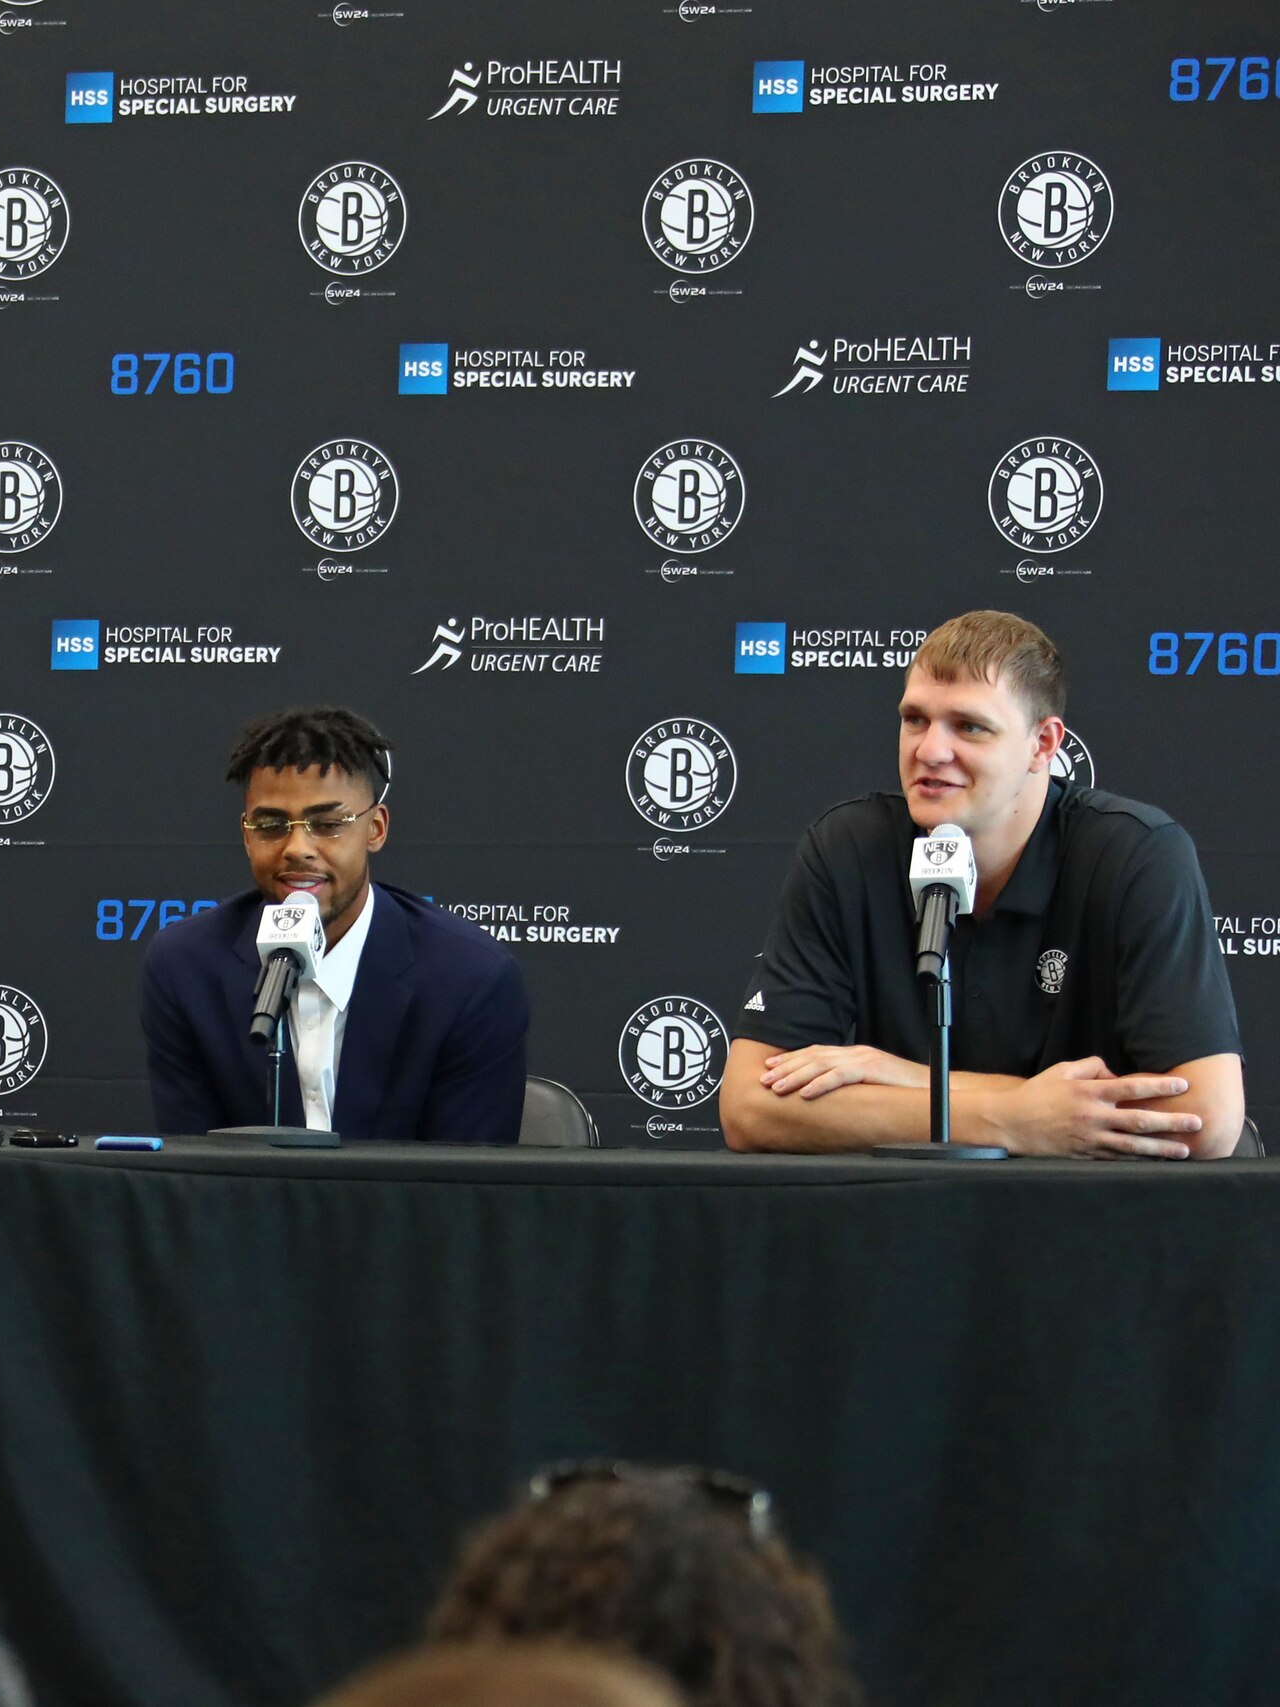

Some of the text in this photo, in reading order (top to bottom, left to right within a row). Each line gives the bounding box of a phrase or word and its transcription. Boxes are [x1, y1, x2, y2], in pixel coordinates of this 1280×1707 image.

[488, 60, 621, 84] ProHEALTH
[811, 64, 947, 84] HOSPITAL FOR
[1170, 57, 1280, 101] 876
[120, 76, 247, 95] HOSPITAL FOR
[759, 79, 798, 95] HSS
[809, 83, 999, 105] SPECIAL SURGERY
[71, 90, 108, 106] HSS
[118, 95, 296, 116] SPECIAL SURGERY
[487, 97, 619, 116] URGENT CARE
[308, 167, 398, 203] BROOKLYN
[1009, 157, 1104, 194] BROOKLYN
[1044, 182, 1068, 238] B
[310, 239, 394, 270] NEW YORK
[1010, 230, 1100, 263] NEW YORK
[1029, 282, 1064, 290] SW24
[455, 350, 585, 367] HOSPITAL FOR
[834, 336, 971, 362] ProHEALTH
[1168, 345, 1263, 362] HOSPITAL
[111, 352, 235, 395] 8760
[405, 361, 442, 377] HSS
[1114, 356, 1154, 372] HSS
[453, 371, 636, 387] SPECIAL SURGERY
[833, 374, 969, 394] URGENT CARE
[1166, 366, 1256, 383] SPECIAL
[644, 444, 736, 480] BROOKLYN
[998, 442, 1094, 479] BROOKLYN
[678, 469, 701, 524] B
[10, 517, 50, 548] YORK
[645, 517, 732, 548] NEW YORK
[1000, 516, 1089, 547] NEW YORK
[663, 567, 697, 575] SW24
[106, 627, 232, 643] HOSPITAL FOR
[471, 617, 604, 641] ProHEALTH
[793, 630, 927, 647] HOSPITAL FOR
[57, 637, 94, 652] HSS
[741, 640, 780, 656] HSS
[1149, 632, 1280, 676] 8760
[104, 647, 281, 663] SPECIAL SURGERY
[471, 654, 602, 672] URGENT CARE
[791, 650, 878, 667] SPECIAL
[636, 723, 728, 759] BROOKLYN
[3, 790, 43, 819] YORK
[637, 795, 724, 826] NEW YORK
[925, 842, 956, 853] NETS
[273, 909, 303, 920] NETS
[449, 904, 569, 922] OSPITAL FOR
[526, 926, 620, 943] SURGERY
[1251, 917, 1280, 935] FO
[628, 1001, 721, 1038] BROOKLYN
[663, 1026, 686, 1081] B
[630, 1073, 717, 1104] NEW YORK
[648, 1123, 683, 1131] SW24
